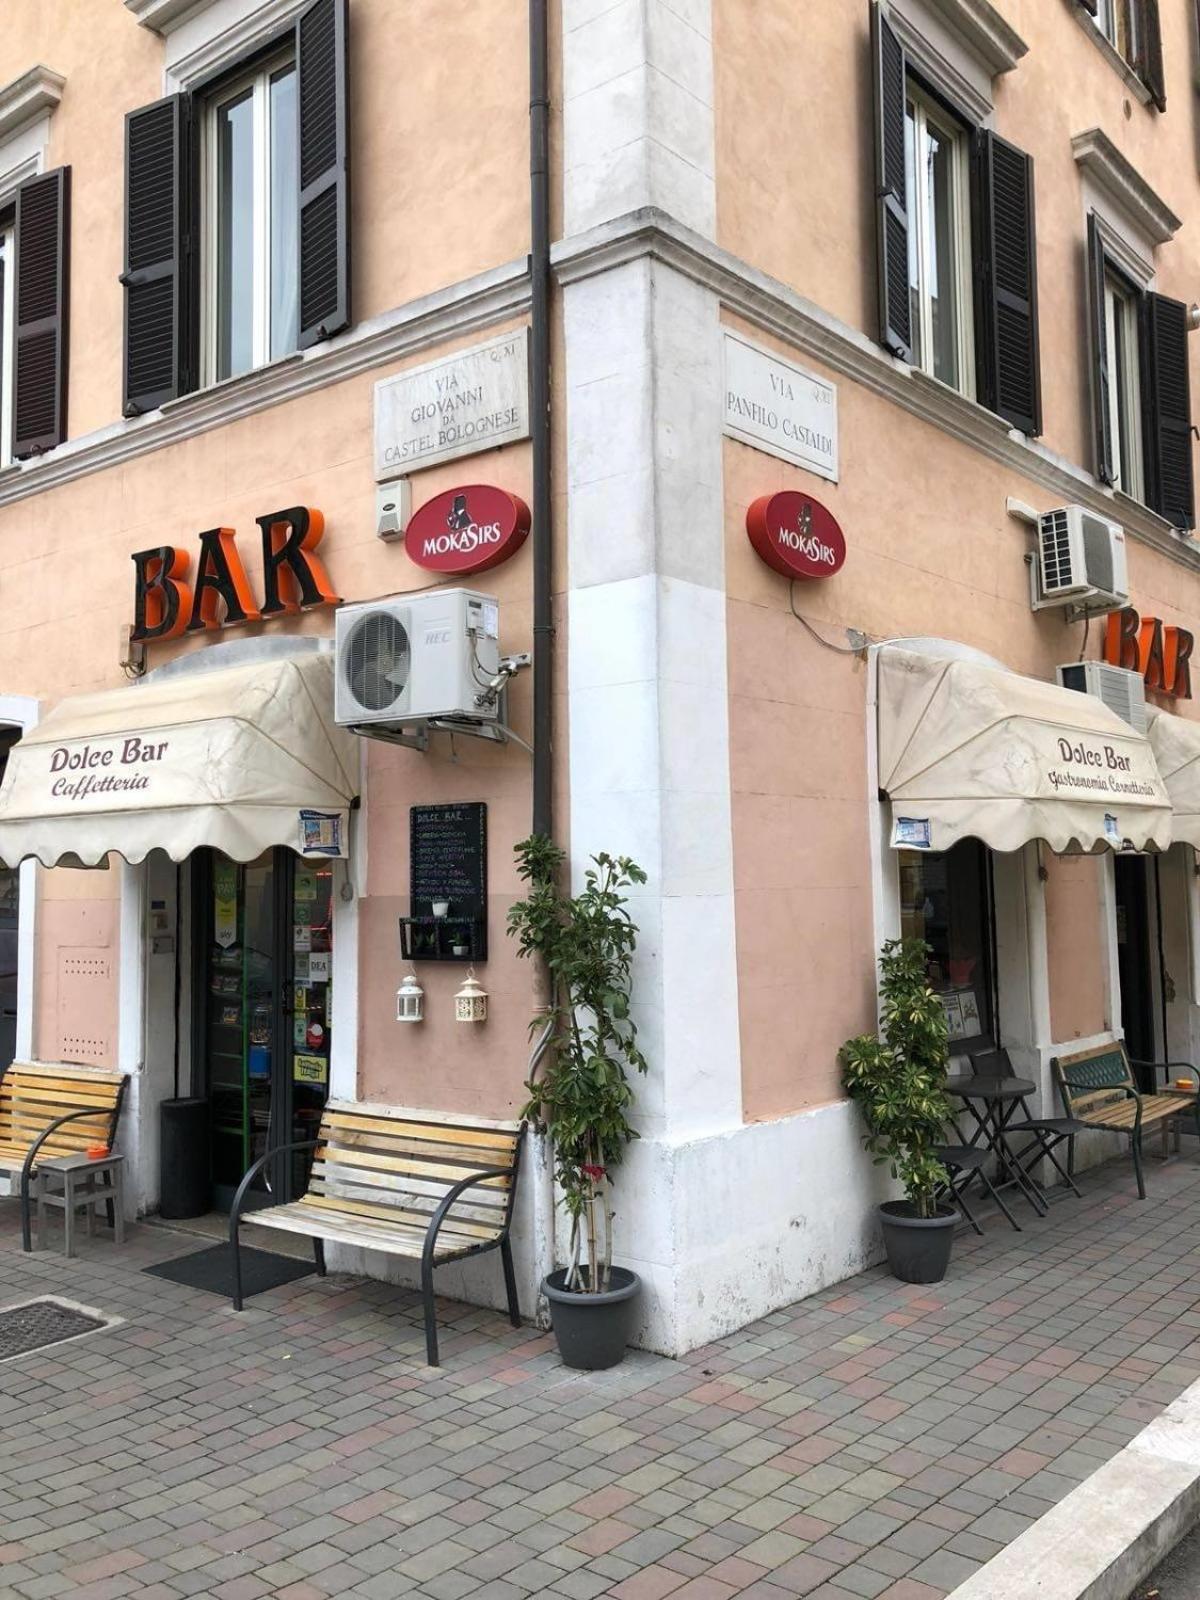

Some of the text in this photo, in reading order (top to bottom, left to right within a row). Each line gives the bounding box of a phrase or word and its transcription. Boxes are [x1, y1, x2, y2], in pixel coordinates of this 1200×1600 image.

[436, 375, 459, 392] VIA
[770, 373, 794, 400] VIA
[411, 386, 482, 423] GIOVANNI
[443, 414, 455, 426] DA
[384, 407, 519, 462] CASTEL BOLOGNESE
[728, 391, 832, 456] PANFILO CASTALDI
[422, 522, 501, 557] MOKASIRS
[779, 527, 836, 566] MOKASIRS
[130, 506, 344, 642] BAR
[1103, 606, 1195, 700] BAR
[50, 737, 169, 773] Dolce Bar
[1057, 737, 1130, 773] Dolce Bar
[51, 773, 149, 801] Caffetteria
[311, 960, 326, 972] DEA
